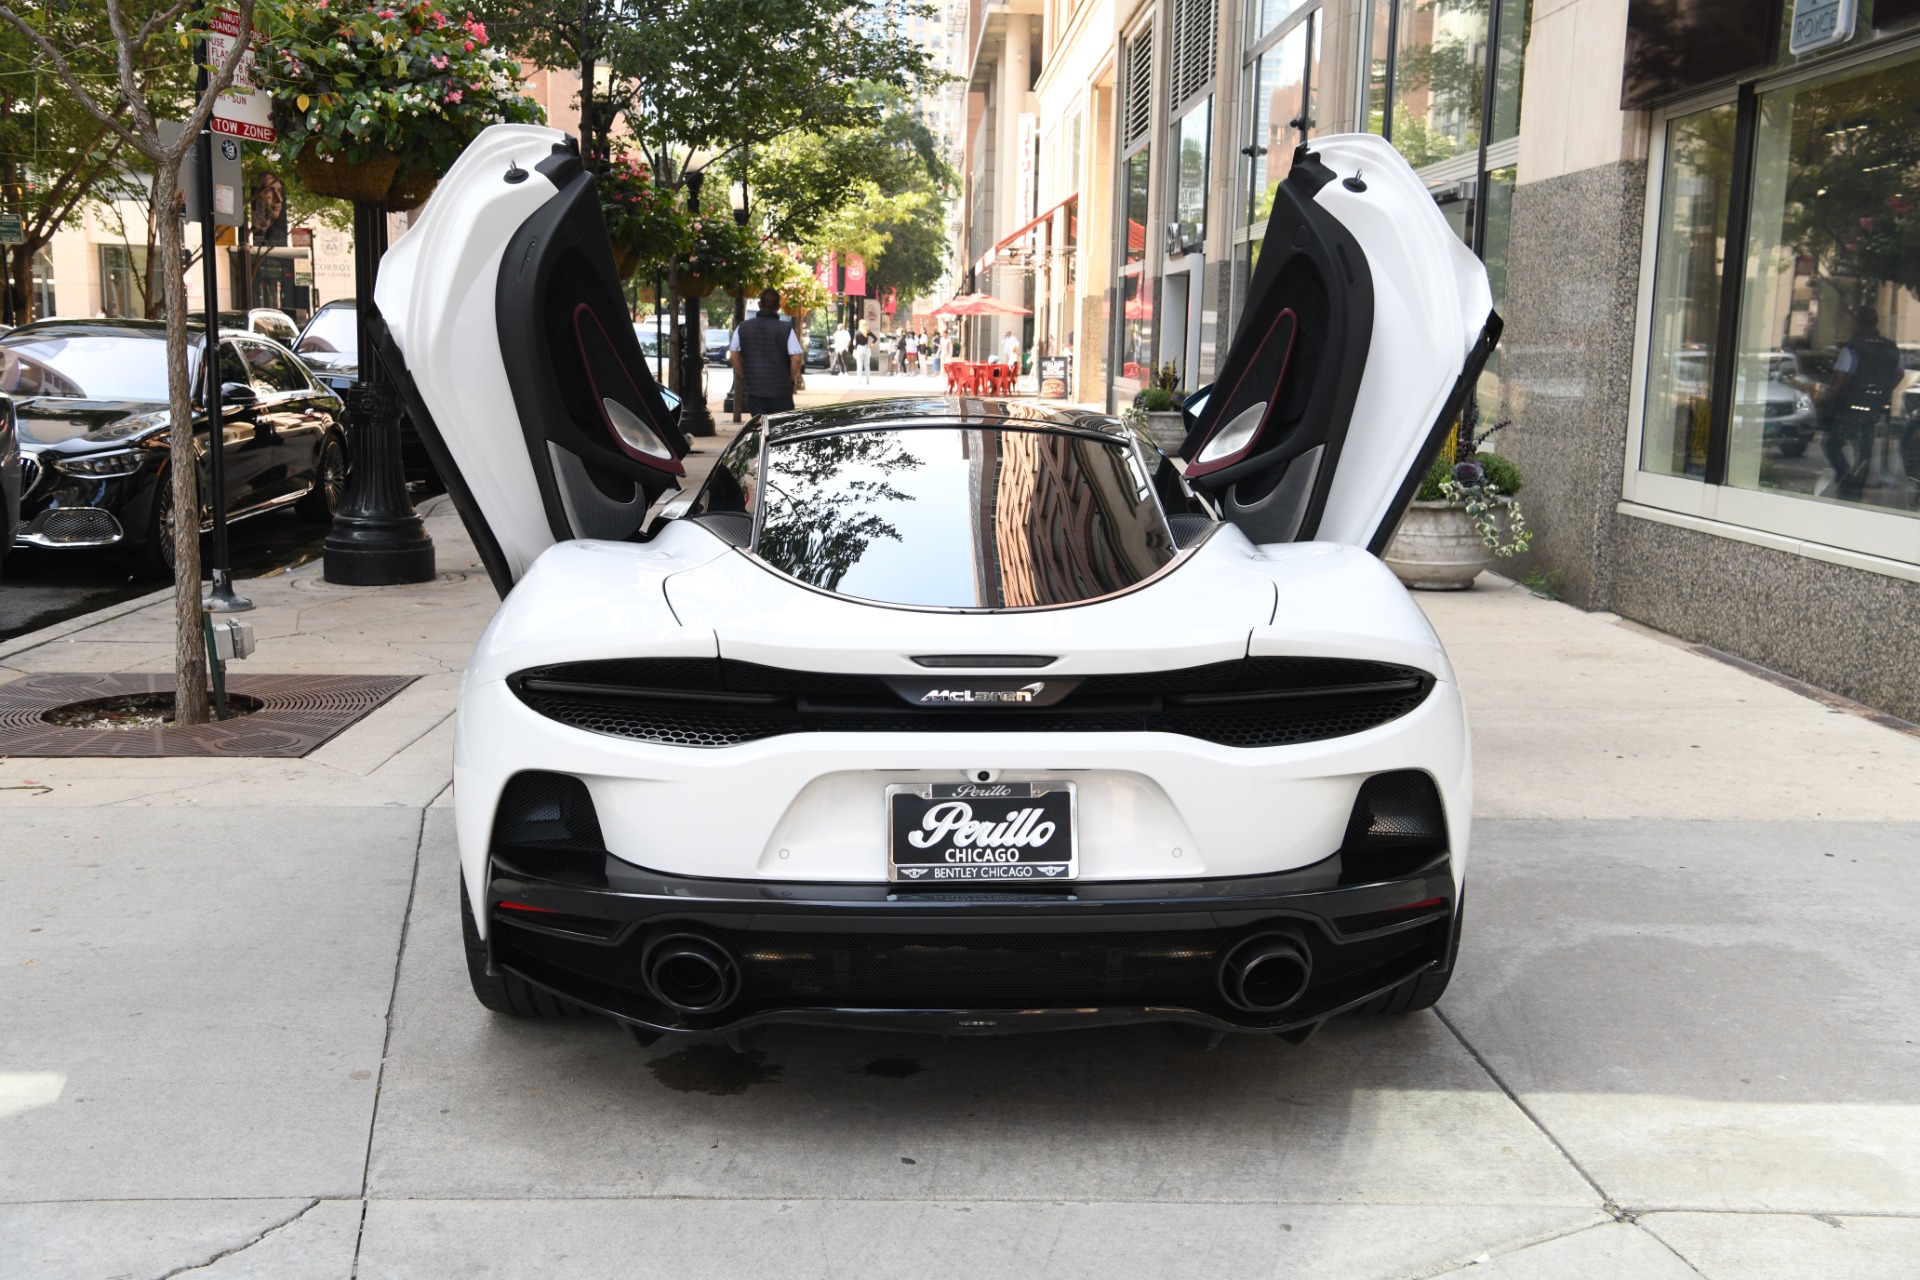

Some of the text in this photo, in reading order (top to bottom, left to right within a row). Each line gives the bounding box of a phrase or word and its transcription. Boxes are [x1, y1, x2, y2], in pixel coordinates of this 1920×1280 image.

[210, 18, 239, 35] STANDIN
[1796, 9, 1837, 41] ROYCE
[211, 37, 225, 48] USE
[232, 94, 247, 106] SUN
[215, 118, 272, 140] TOW ZONE
[920, 689, 1032, 702] McLaren
[951, 784, 1012, 798] Perillo
[907, 801, 1056, 849] Perillo
[944, 848, 1020, 863] CHICAGO
[934, 866, 1032, 879] BENTLEY CHICAGO
